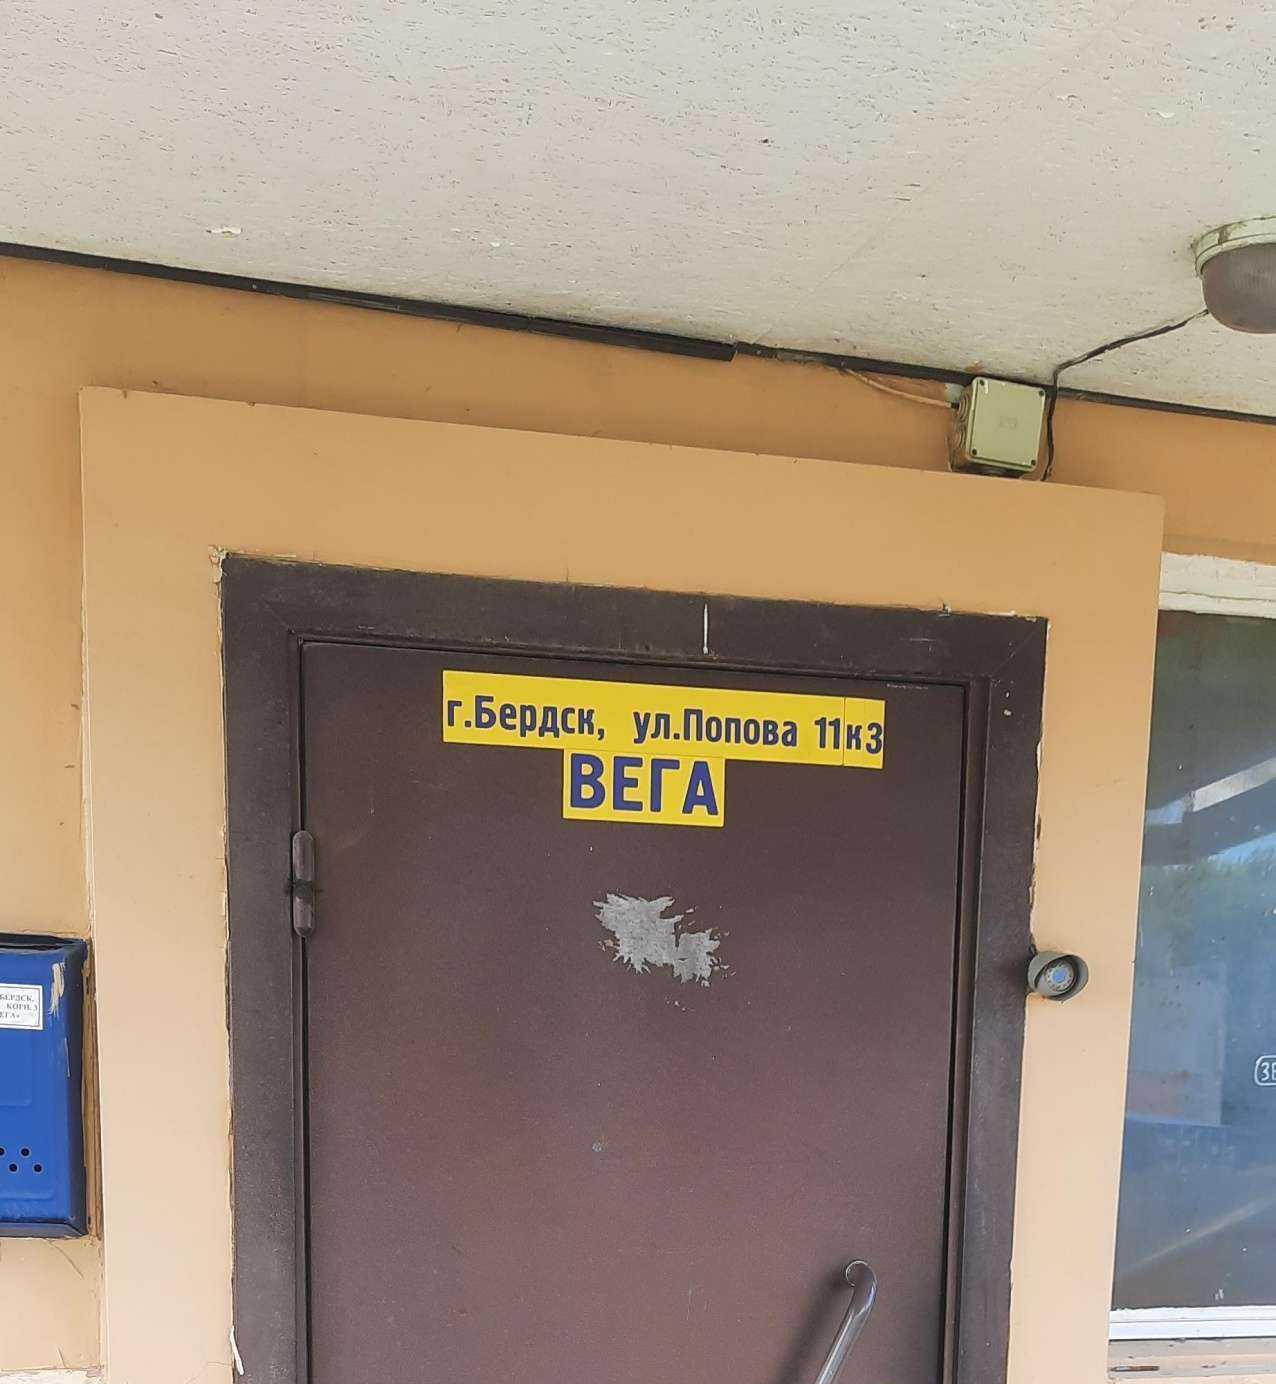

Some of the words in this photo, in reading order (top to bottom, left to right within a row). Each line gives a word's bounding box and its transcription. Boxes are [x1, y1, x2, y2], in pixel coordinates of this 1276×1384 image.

[446, 694, 605, 741] г.Бердск,
[633, 708, 798, 748] ул.Попова
[569, 752, 719, 816] ВЕГА
